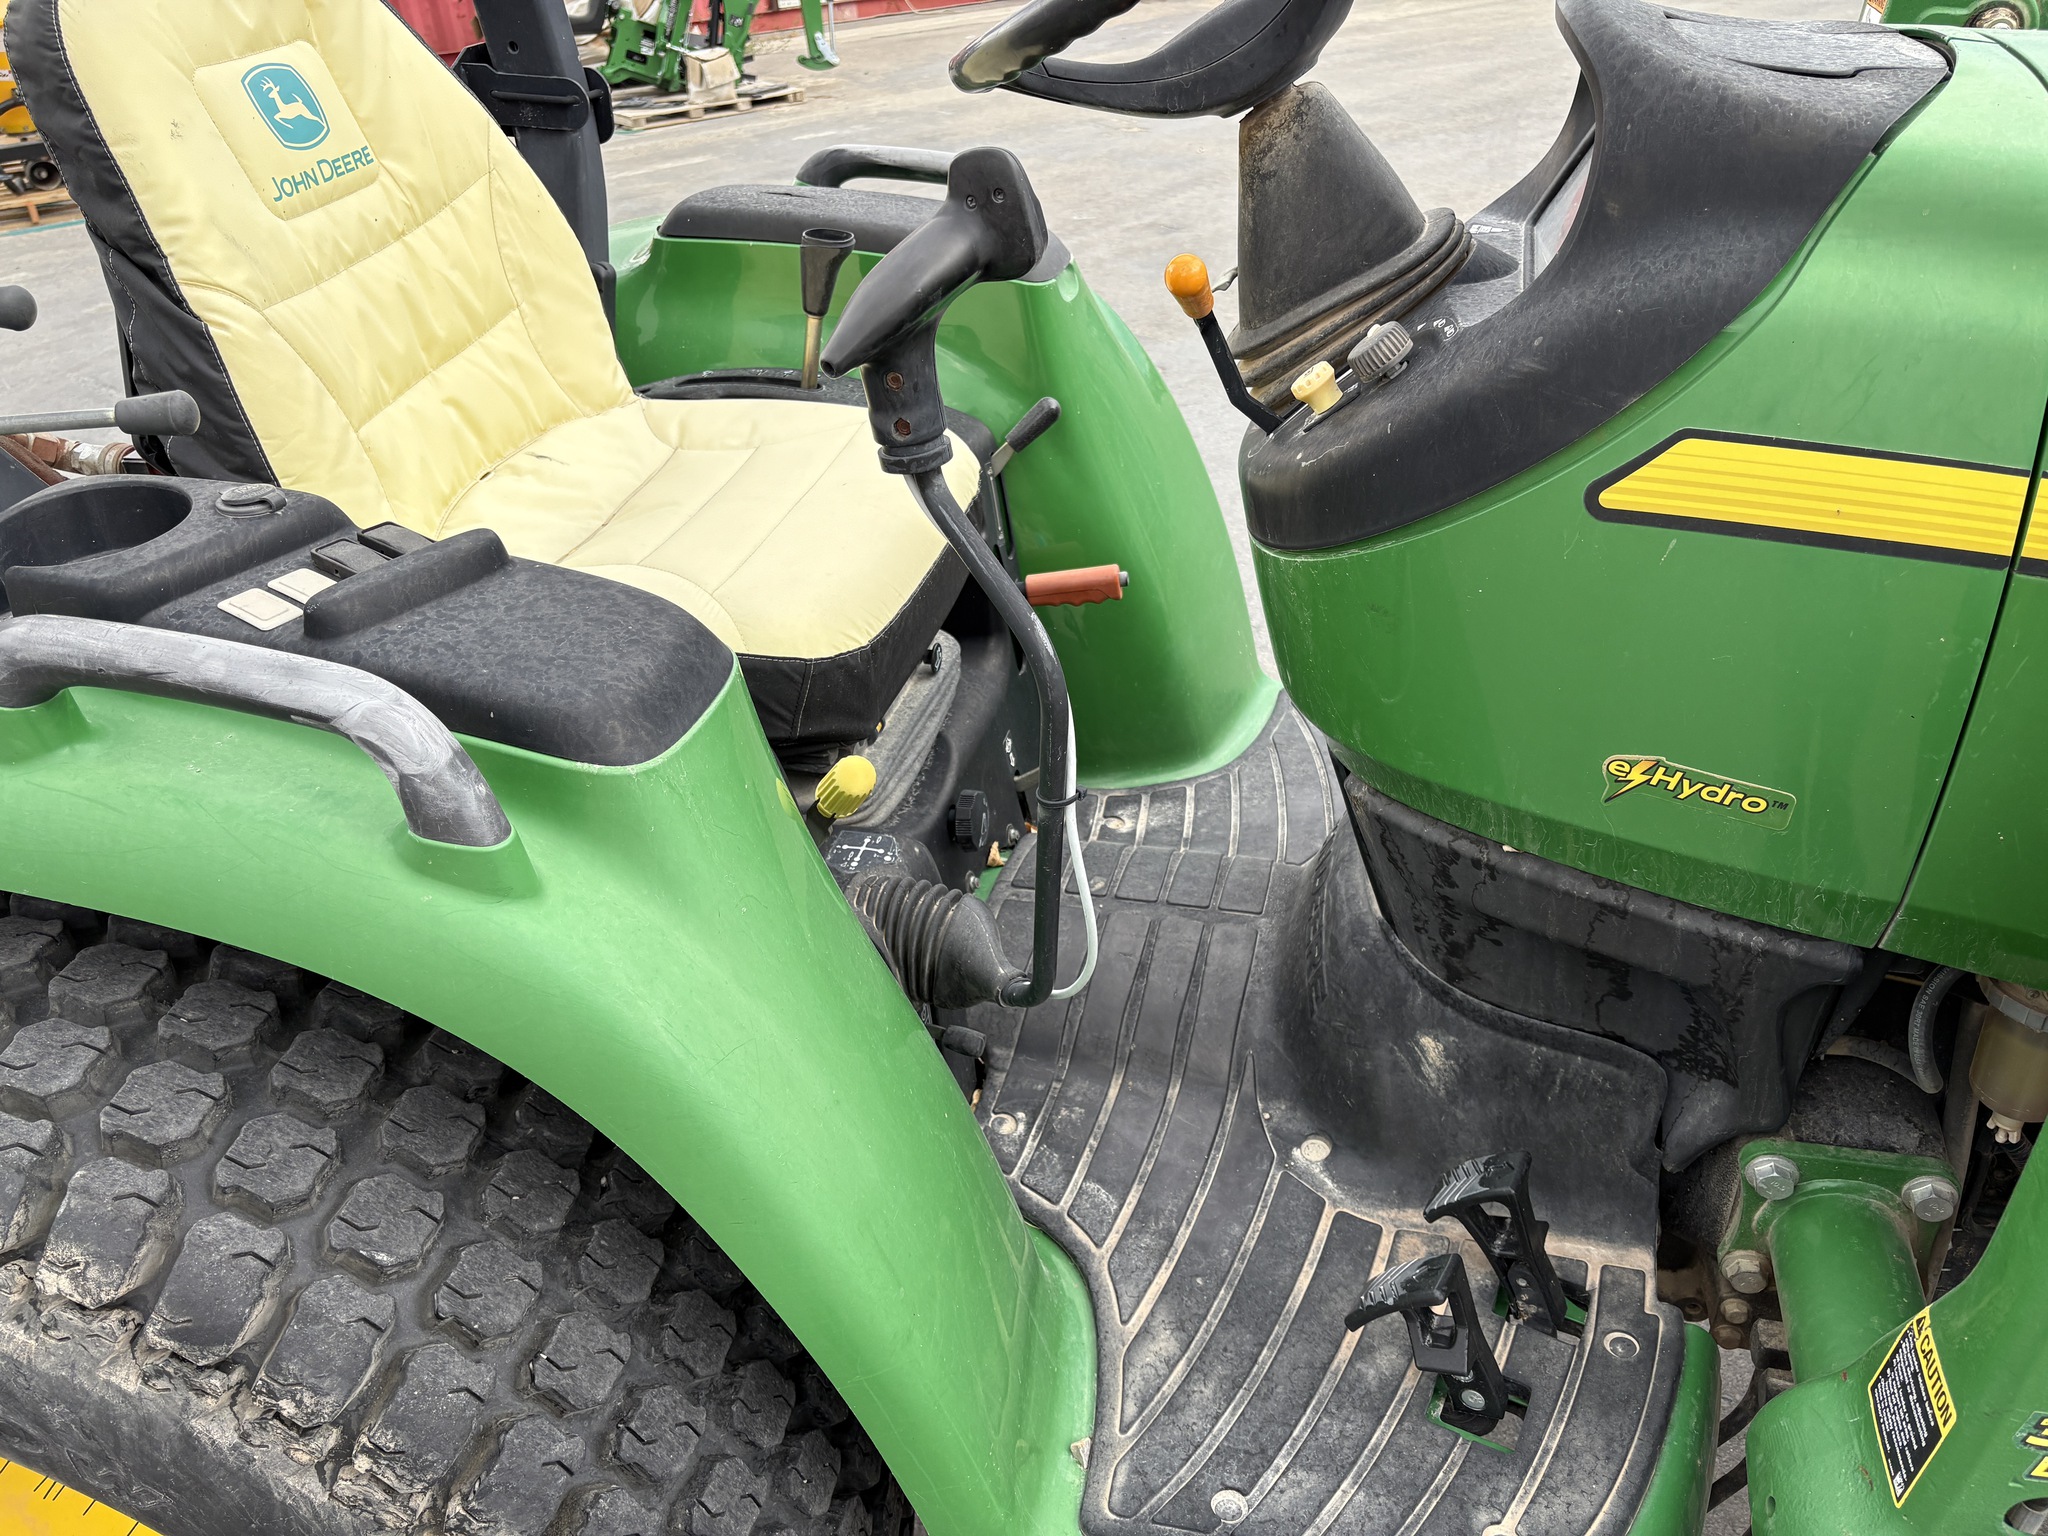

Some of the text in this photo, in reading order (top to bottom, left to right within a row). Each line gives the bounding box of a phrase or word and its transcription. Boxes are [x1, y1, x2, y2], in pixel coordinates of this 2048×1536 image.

[272, 145, 375, 202] JOHN DEERE
[1919, 994, 1929, 1010] SAE
[1920, 1334, 1952, 1427] CAUTION
